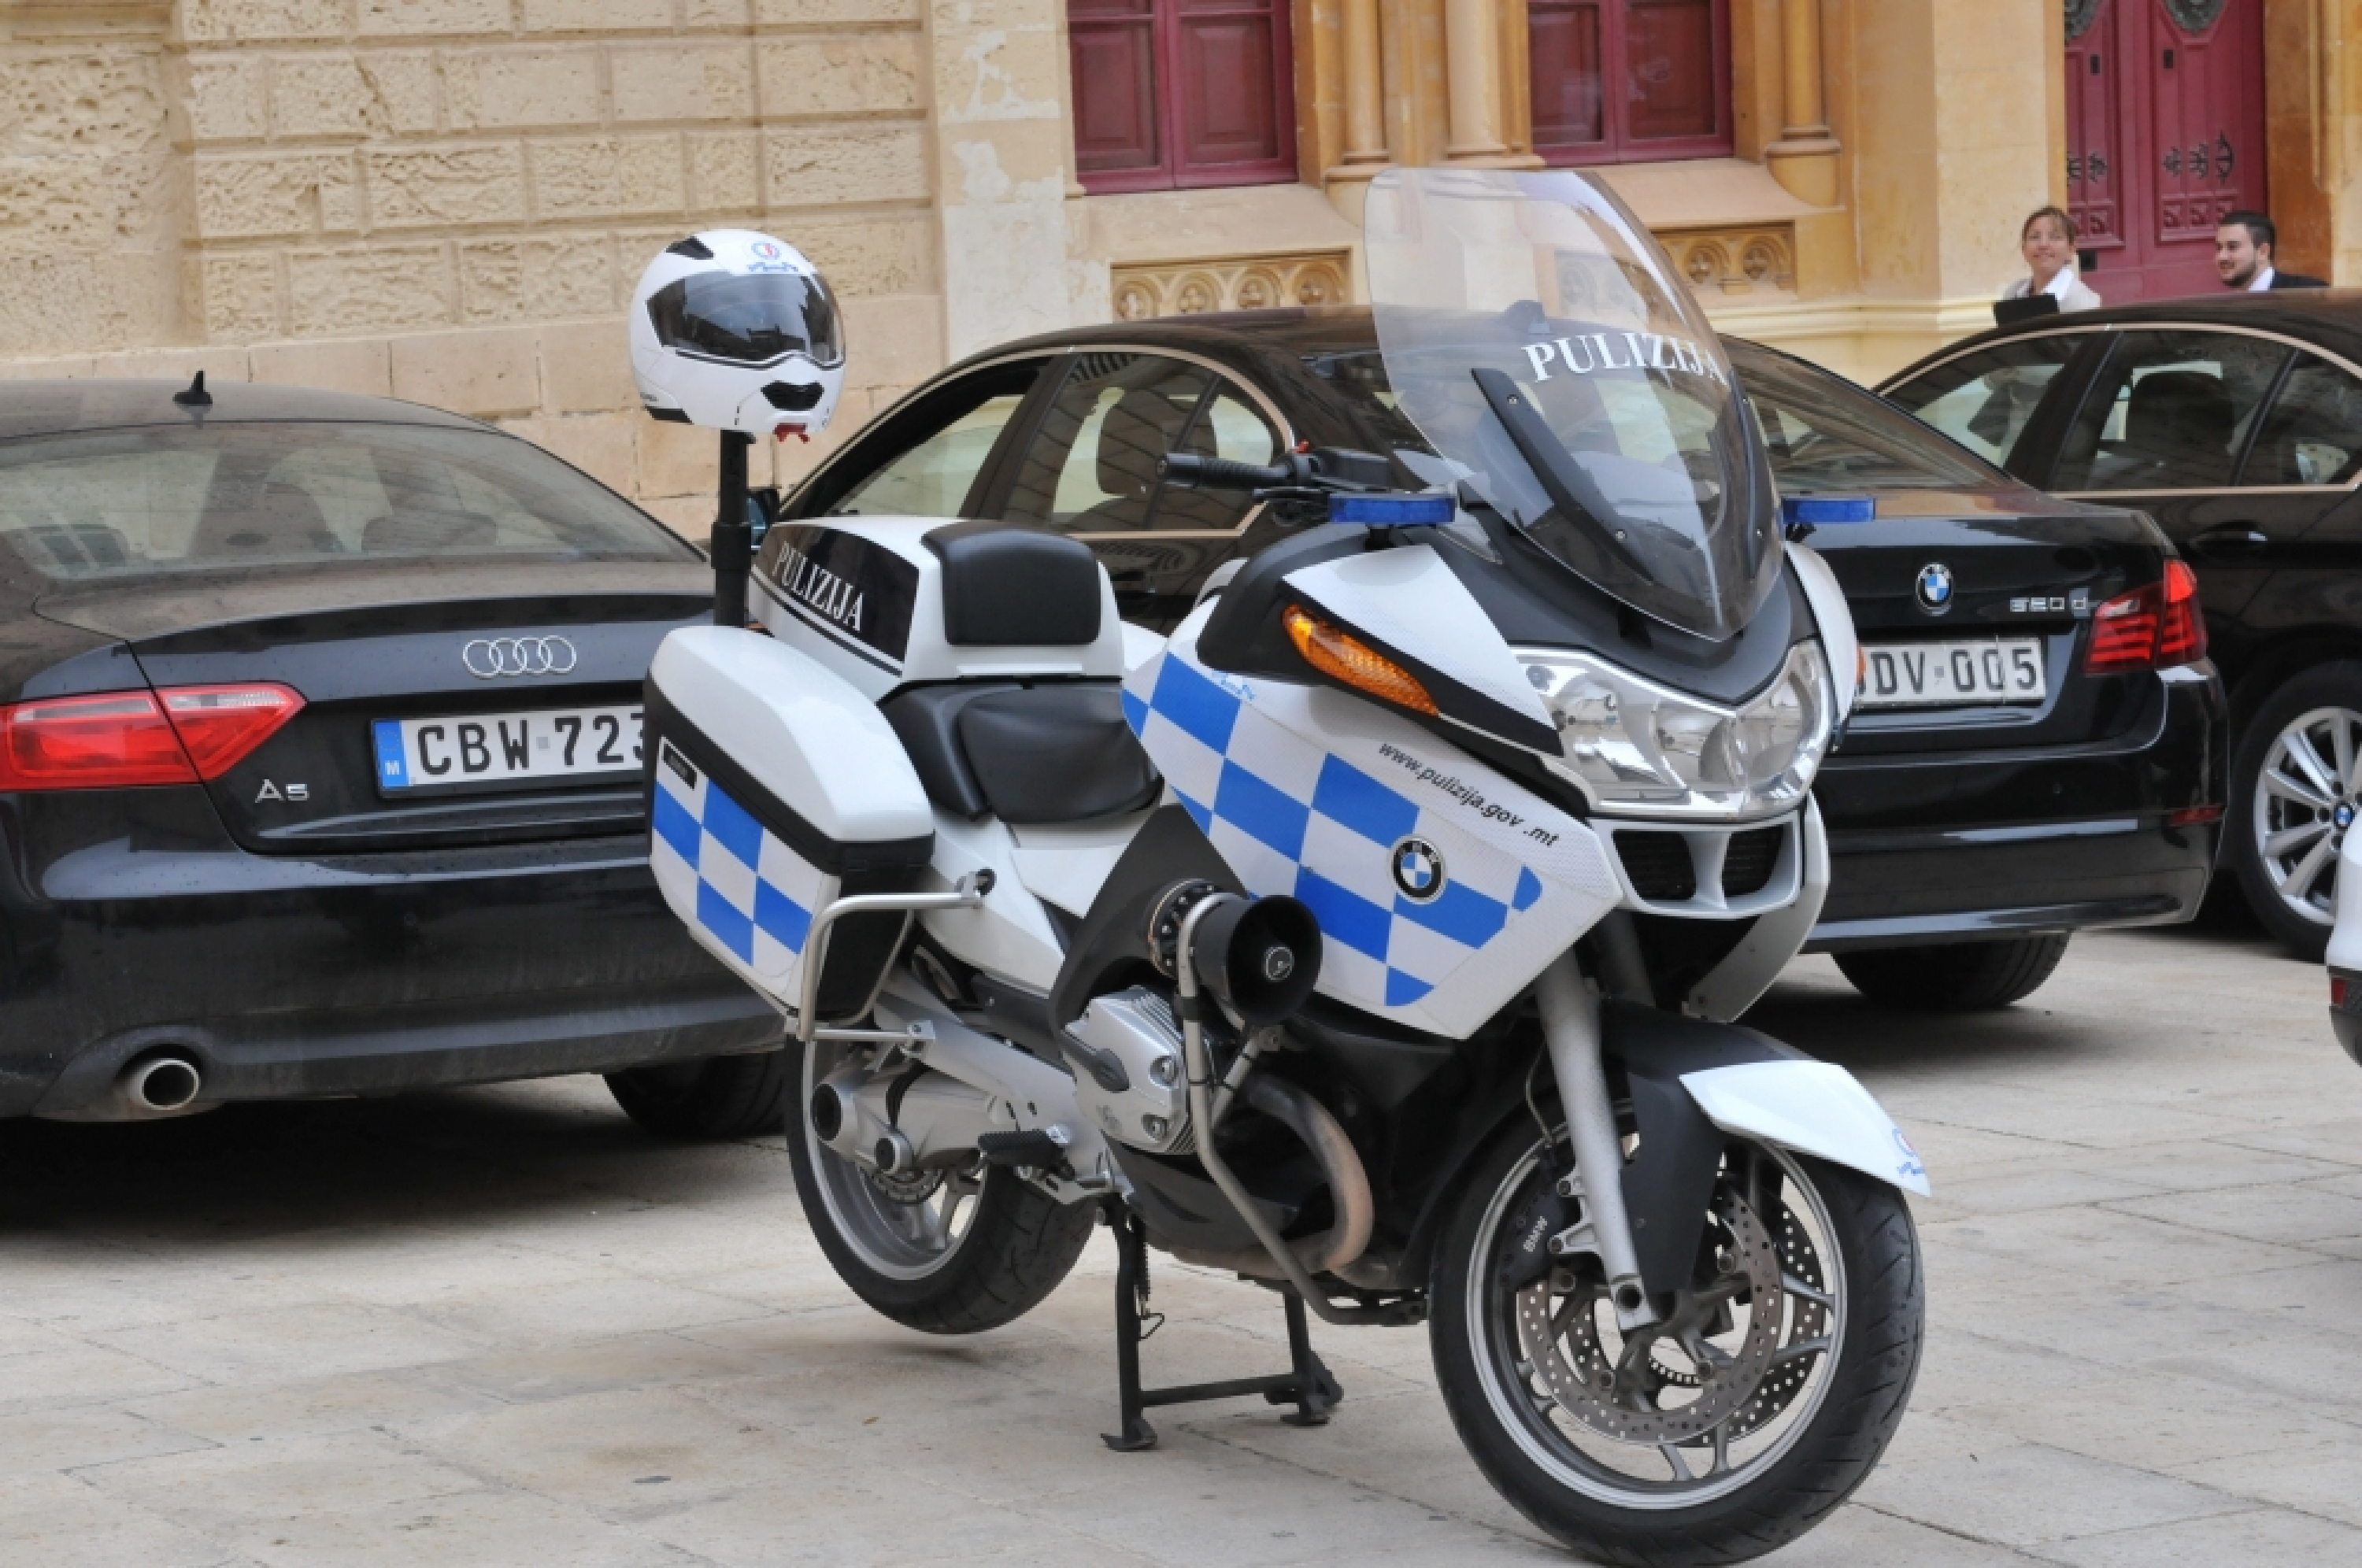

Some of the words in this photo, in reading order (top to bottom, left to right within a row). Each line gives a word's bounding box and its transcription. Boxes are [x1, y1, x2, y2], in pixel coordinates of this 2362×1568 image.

[1520, 332, 1728, 386] PULIZIJA
[772, 540, 864, 633] PULIZIJA
[1858, 649, 1927, 696] DV
[1949, 646, 2038, 693] 005
[416, 719, 531, 776] CBW
[254, 778, 310, 804] A5
